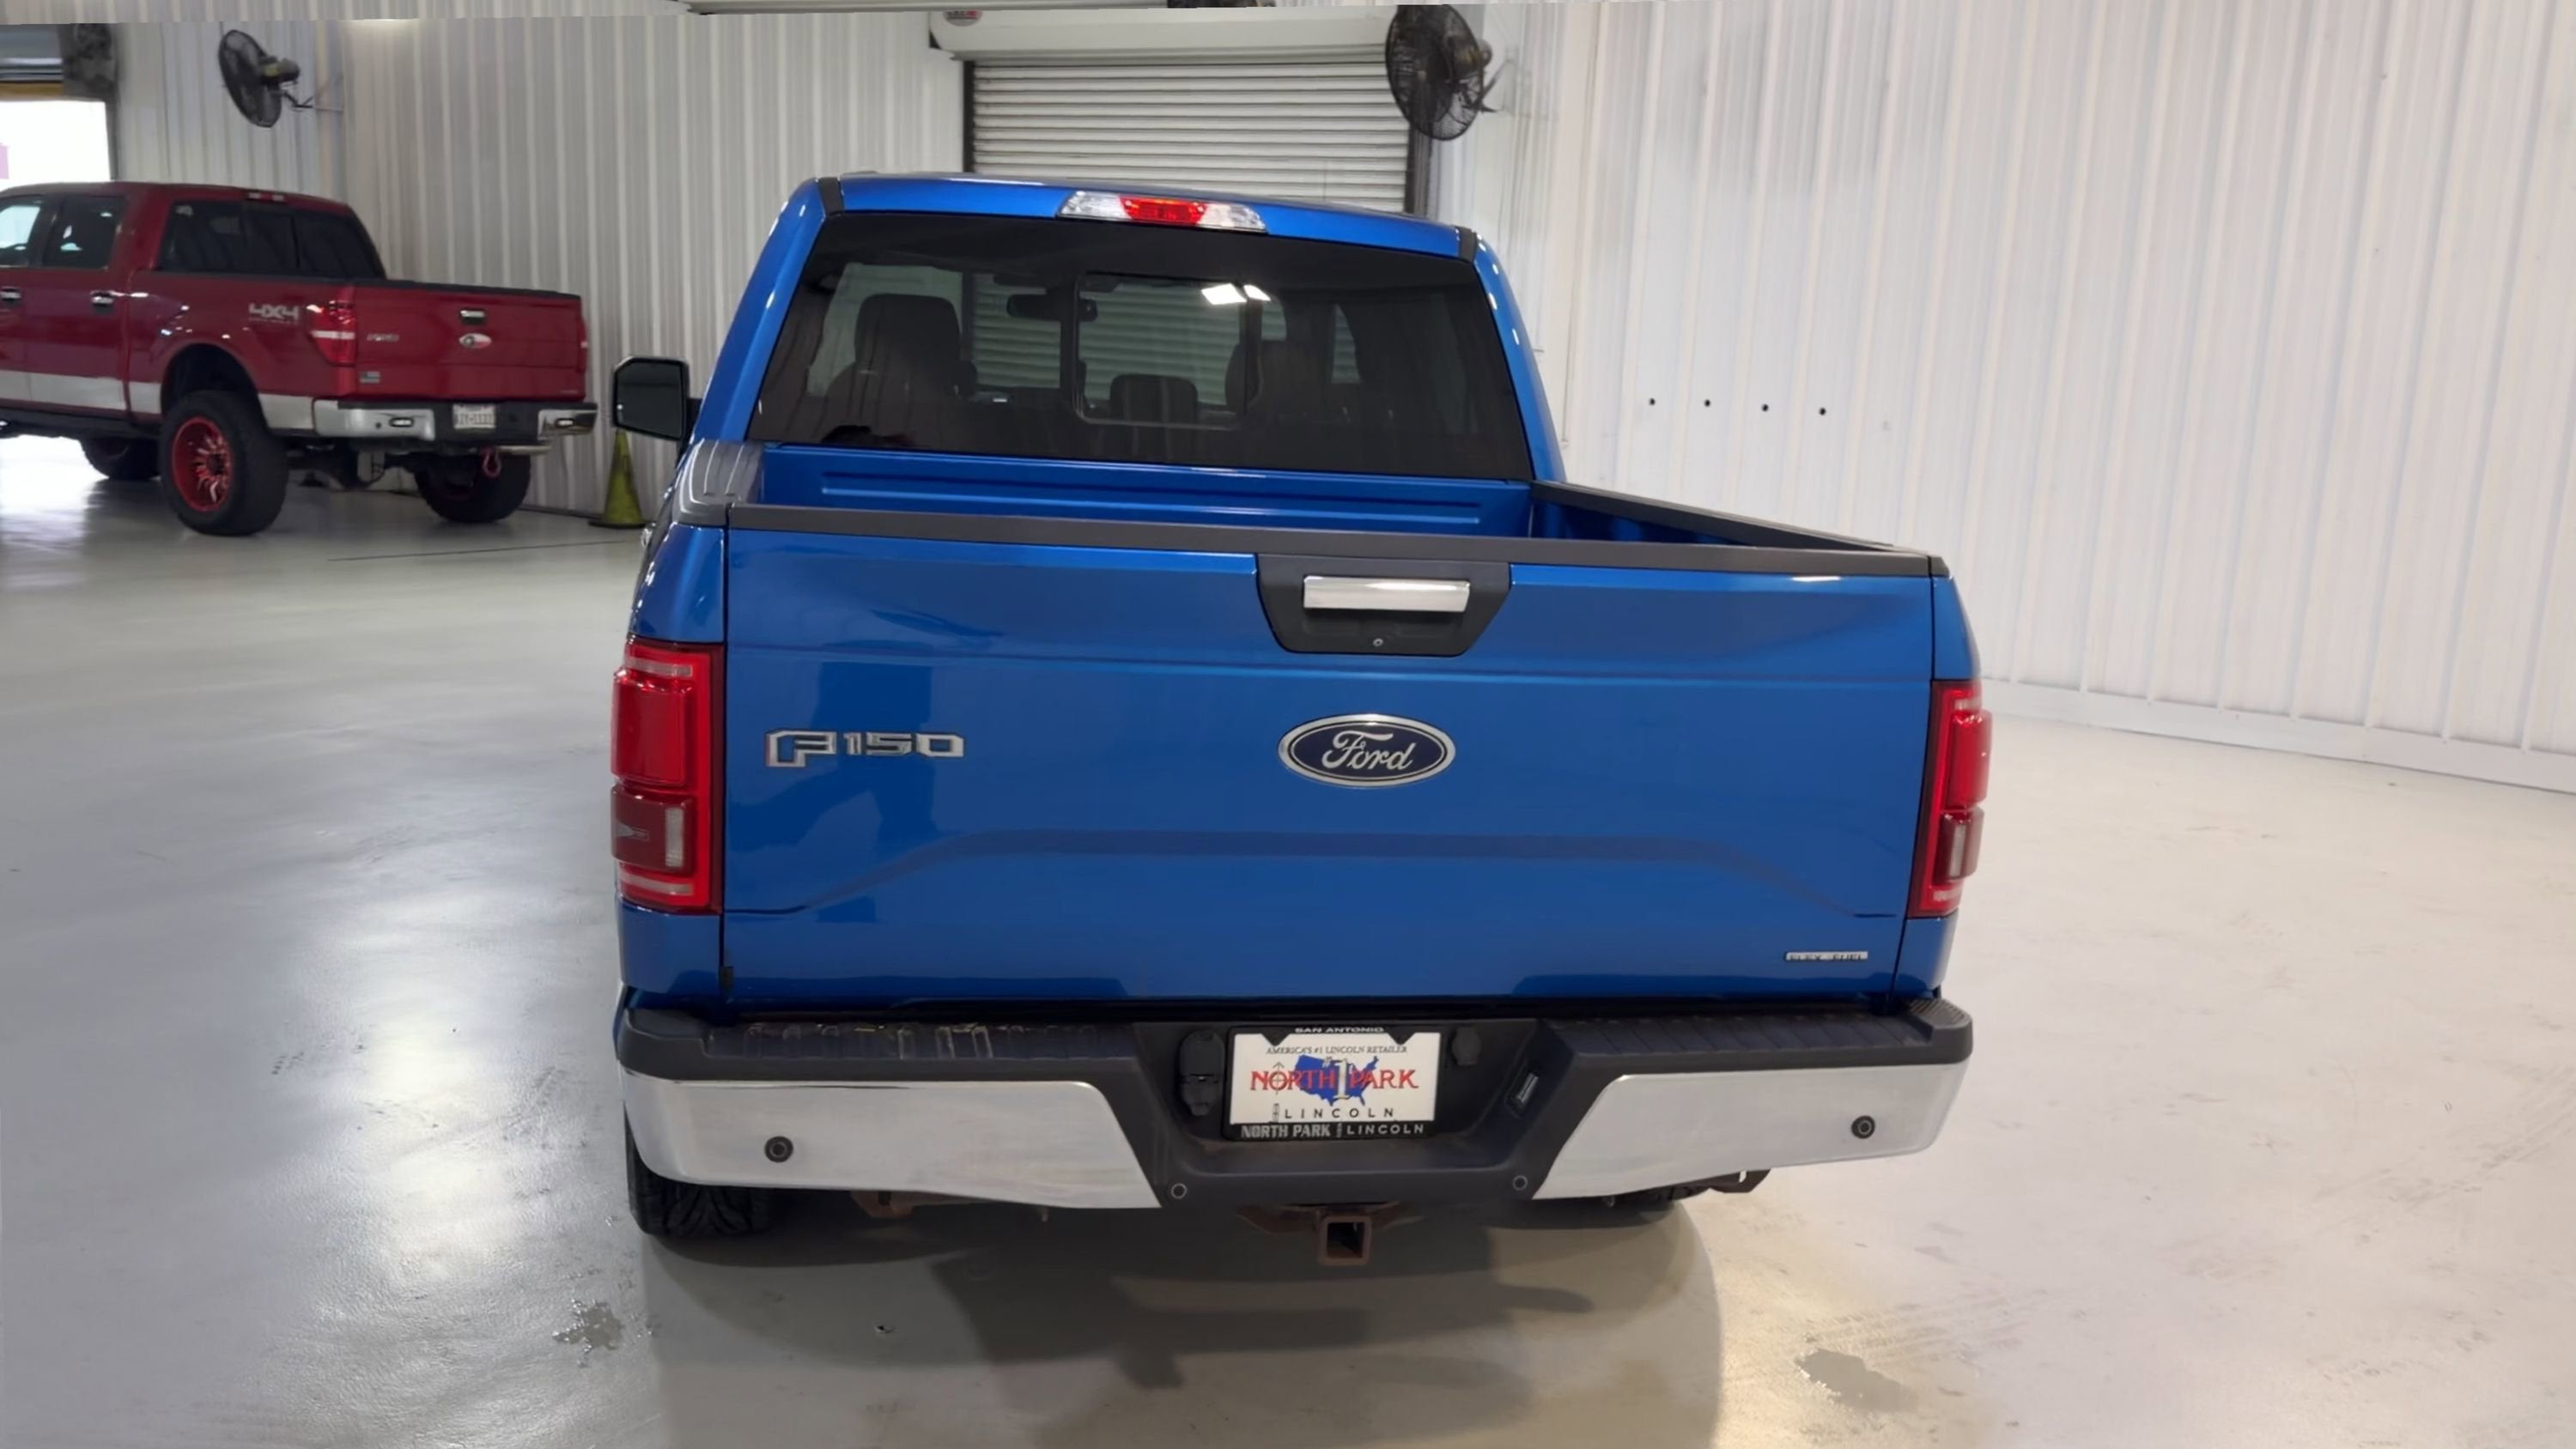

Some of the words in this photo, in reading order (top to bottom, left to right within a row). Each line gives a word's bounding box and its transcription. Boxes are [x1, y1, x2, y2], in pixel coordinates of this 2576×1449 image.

[1321, 730, 1416, 771] Ford
[1366, 1045, 1407, 1053] RETAILER
[1250, 1070, 1336, 1091] NORTH
[1349, 1070, 1419, 1089] PARK
[1285, 1108, 1394, 1119] LINCOLN
[1242, 1125, 1289, 1138] NORTH
[1292, 1124, 1331, 1137] PARK
[1346, 1124, 1425, 1135] LINCOLN
